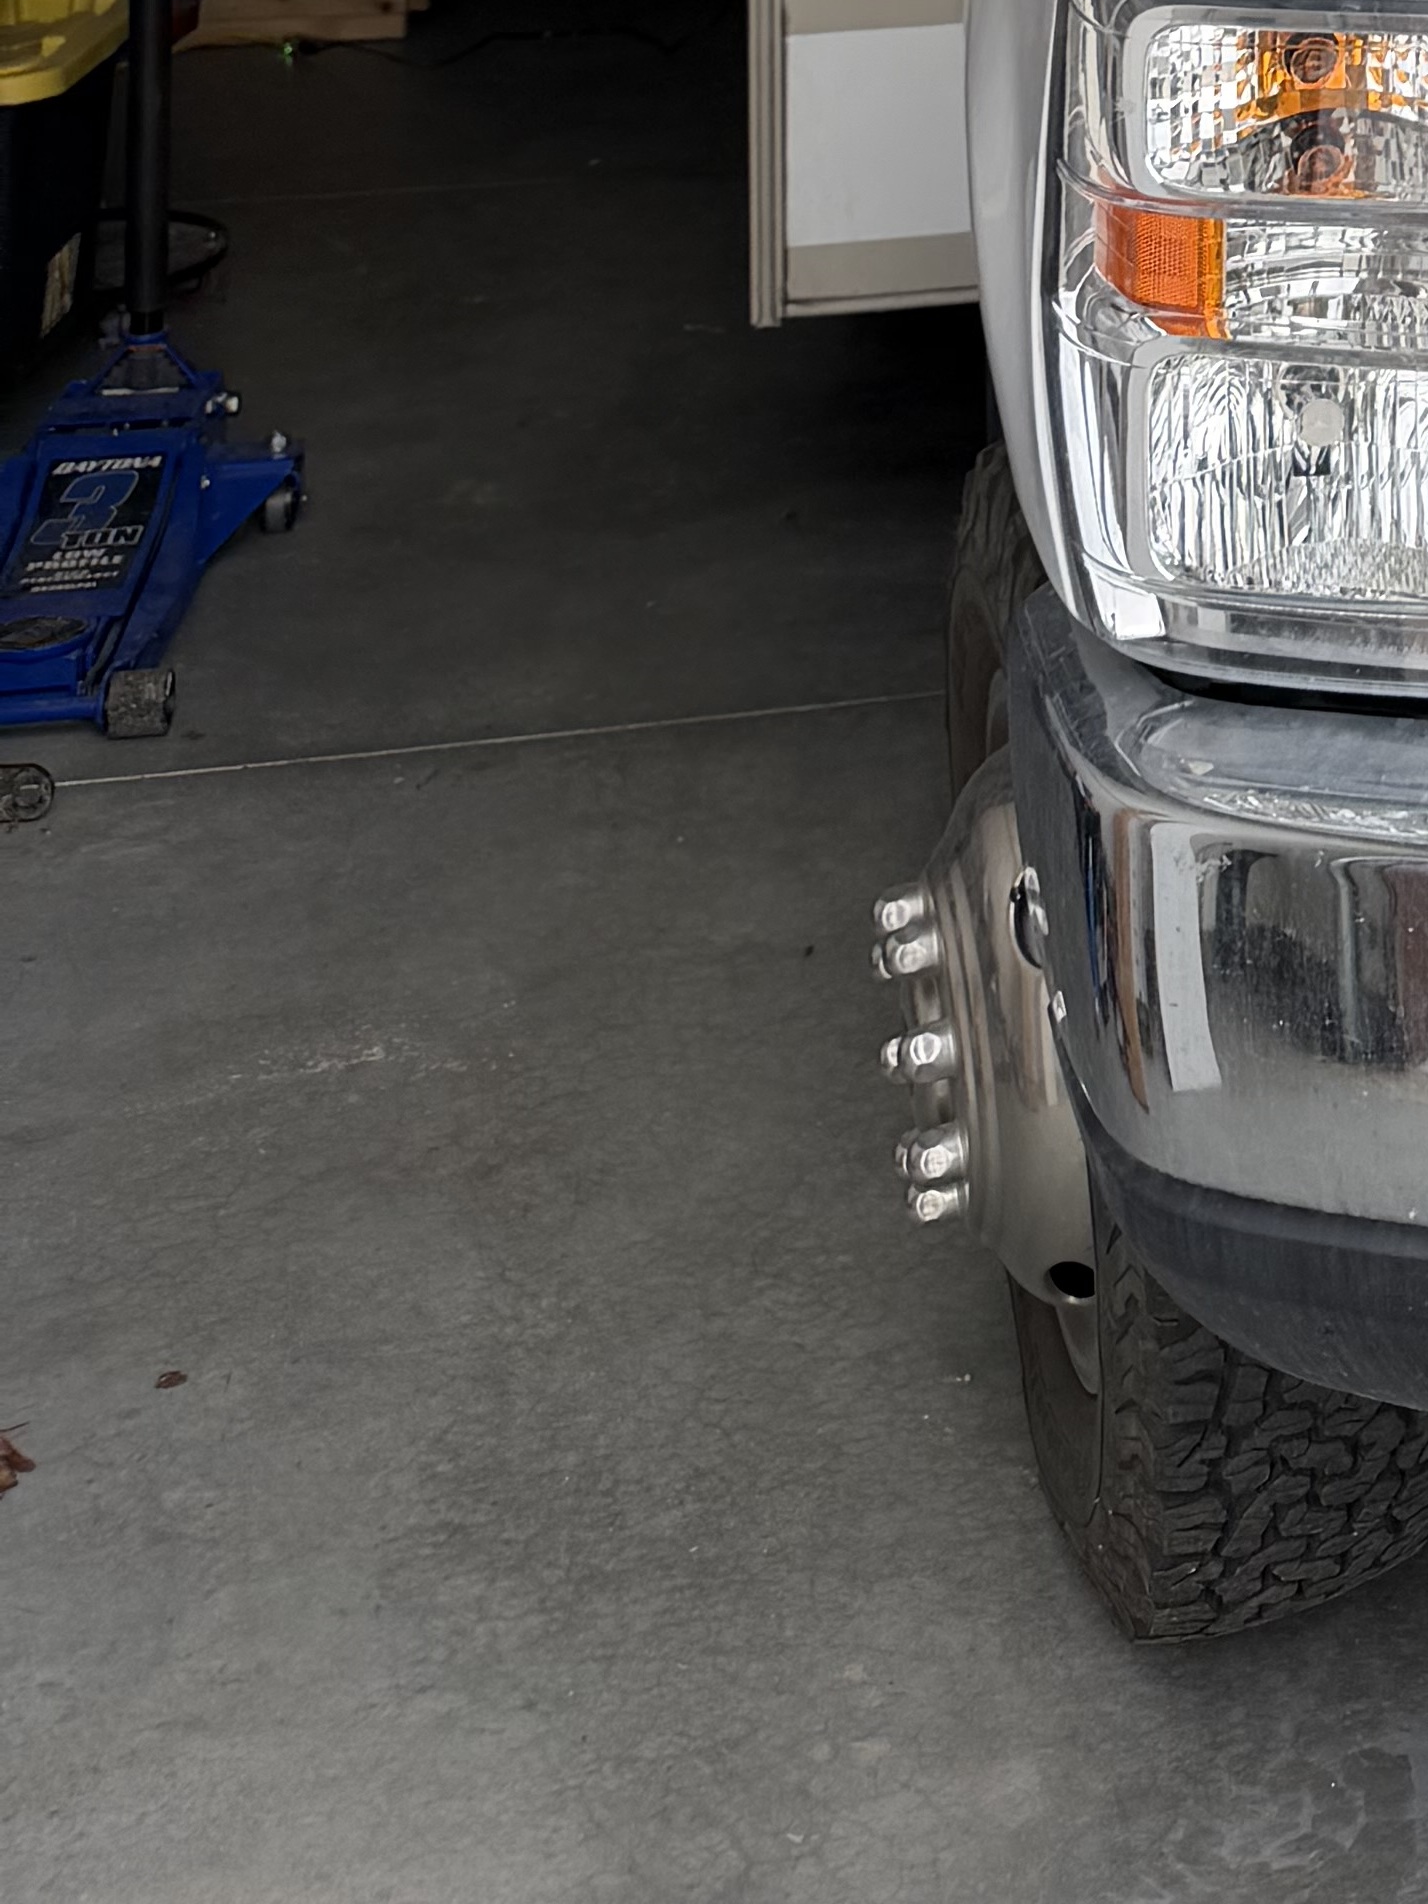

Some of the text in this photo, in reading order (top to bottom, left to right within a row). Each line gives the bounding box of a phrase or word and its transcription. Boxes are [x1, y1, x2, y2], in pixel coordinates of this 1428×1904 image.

[52, 455, 163, 476] DAYTONA
[30, 470, 139, 546] 3
[60, 524, 145, 550] TON
